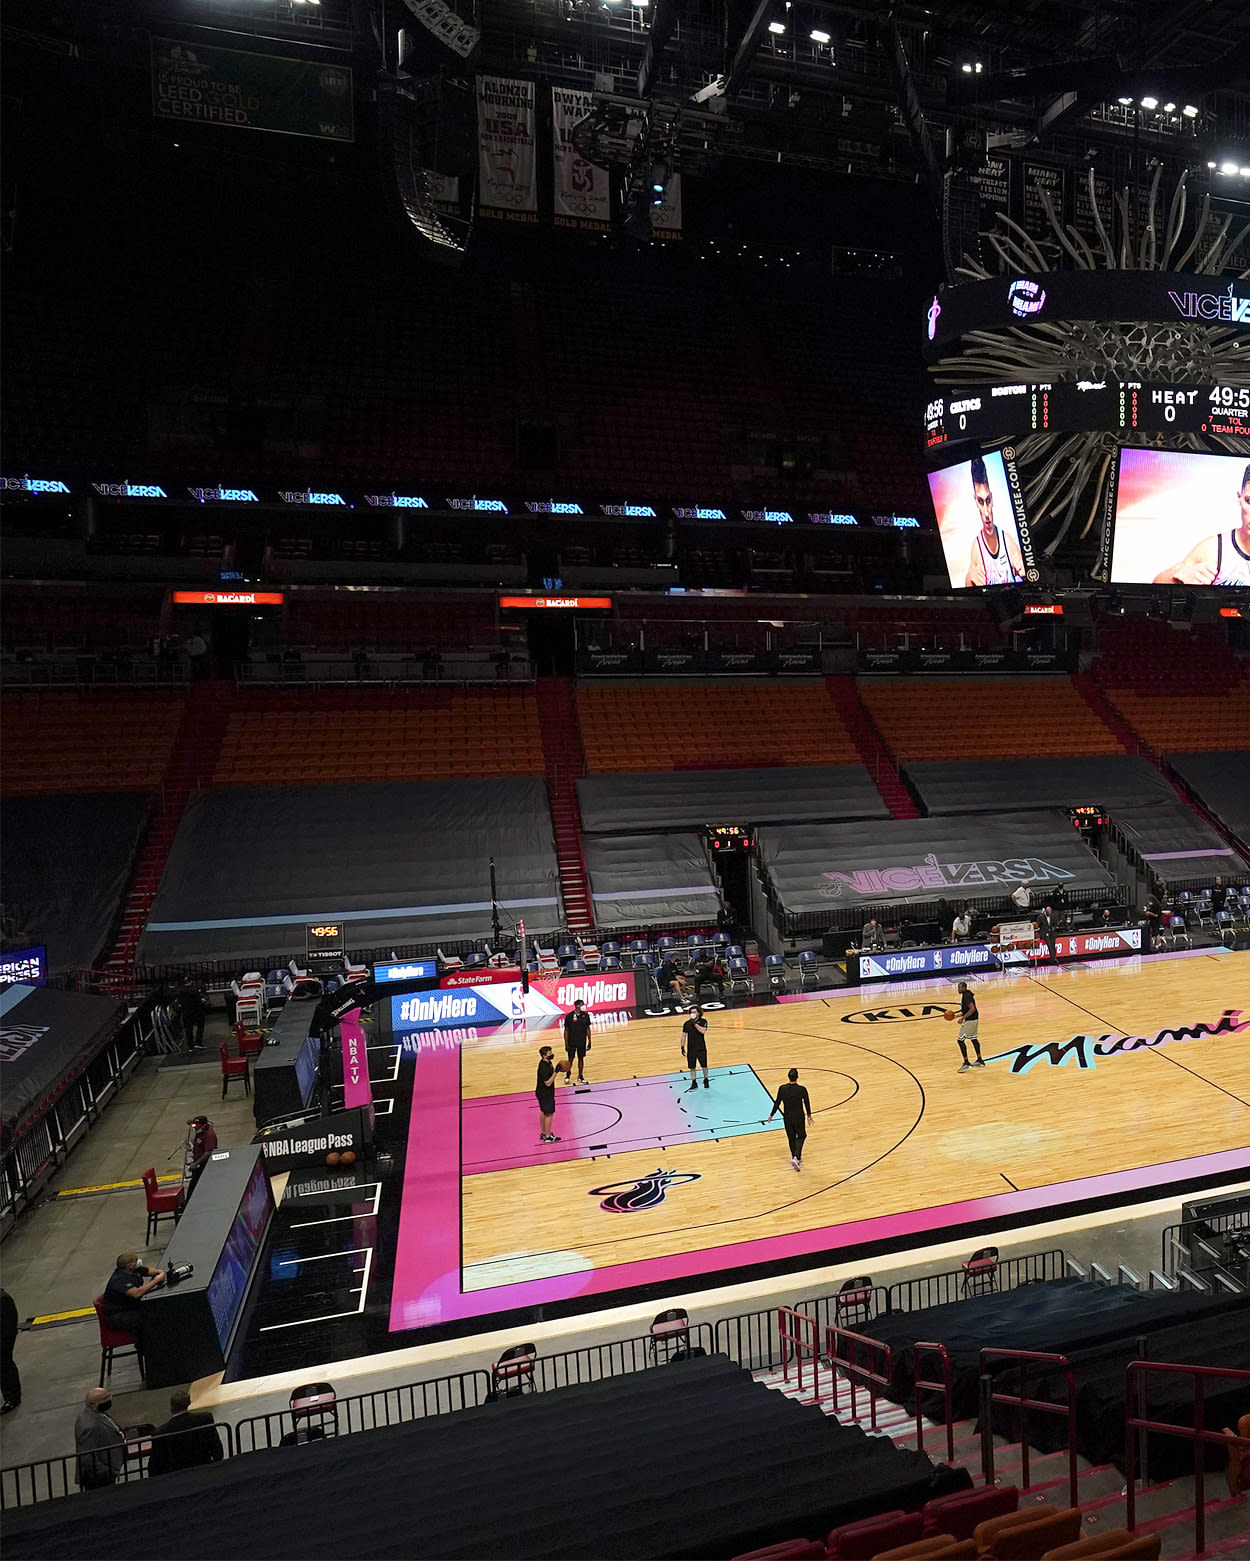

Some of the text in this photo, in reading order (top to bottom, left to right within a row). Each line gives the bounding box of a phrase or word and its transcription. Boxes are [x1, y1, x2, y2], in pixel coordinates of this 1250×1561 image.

[159, 84, 259, 110] LEED GOLD
[484, 82, 528, 96] ALONZO
[479, 93, 534, 109] MOURNING
[159, 100, 251, 124] CERTIFIED.
[486, 118, 530, 137] USA
[479, 208, 539, 223] GOLD MEDAL
[554, 217, 611, 232] GOLD MEDAL
[653, 230, 682, 240] MEDAL
[991, 385, 1027, 397] BOSTON
[1152, 390, 1198, 405] HEAT
[950, 398, 981, 414] CELTICS
[1165, 406, 1175, 422] 0
[1211, 407, 1248, 418] QUARTER
[959, 414, 966, 430] 0
[1211, 425, 1233, 434] TEAM
[1228, 417, 1243, 426] TOL
[1007, 462, 1035, 567] MICCOSUKEE.COM
[1104, 460, 1116, 567] MICCOSUKEE.COM
[717, 827, 739, 835] 49:56
[312, 926, 339, 937] 49:56
[1002, 934, 1018, 942] FedEx
[1085, 934, 1120, 952] #OnlyHere
[886, 955, 926, 973] #OnlyHere
[950, 949, 988, 967] #OnlyHere
[557, 982, 627, 1006] #OnlyHere
[400, 996, 477, 1023] #OnlyHere
[862, 1005, 951, 1022] KIA
[348, 1038, 360, 1084] NBA TV
[268, 1133, 353, 1157] NBA League Pass
